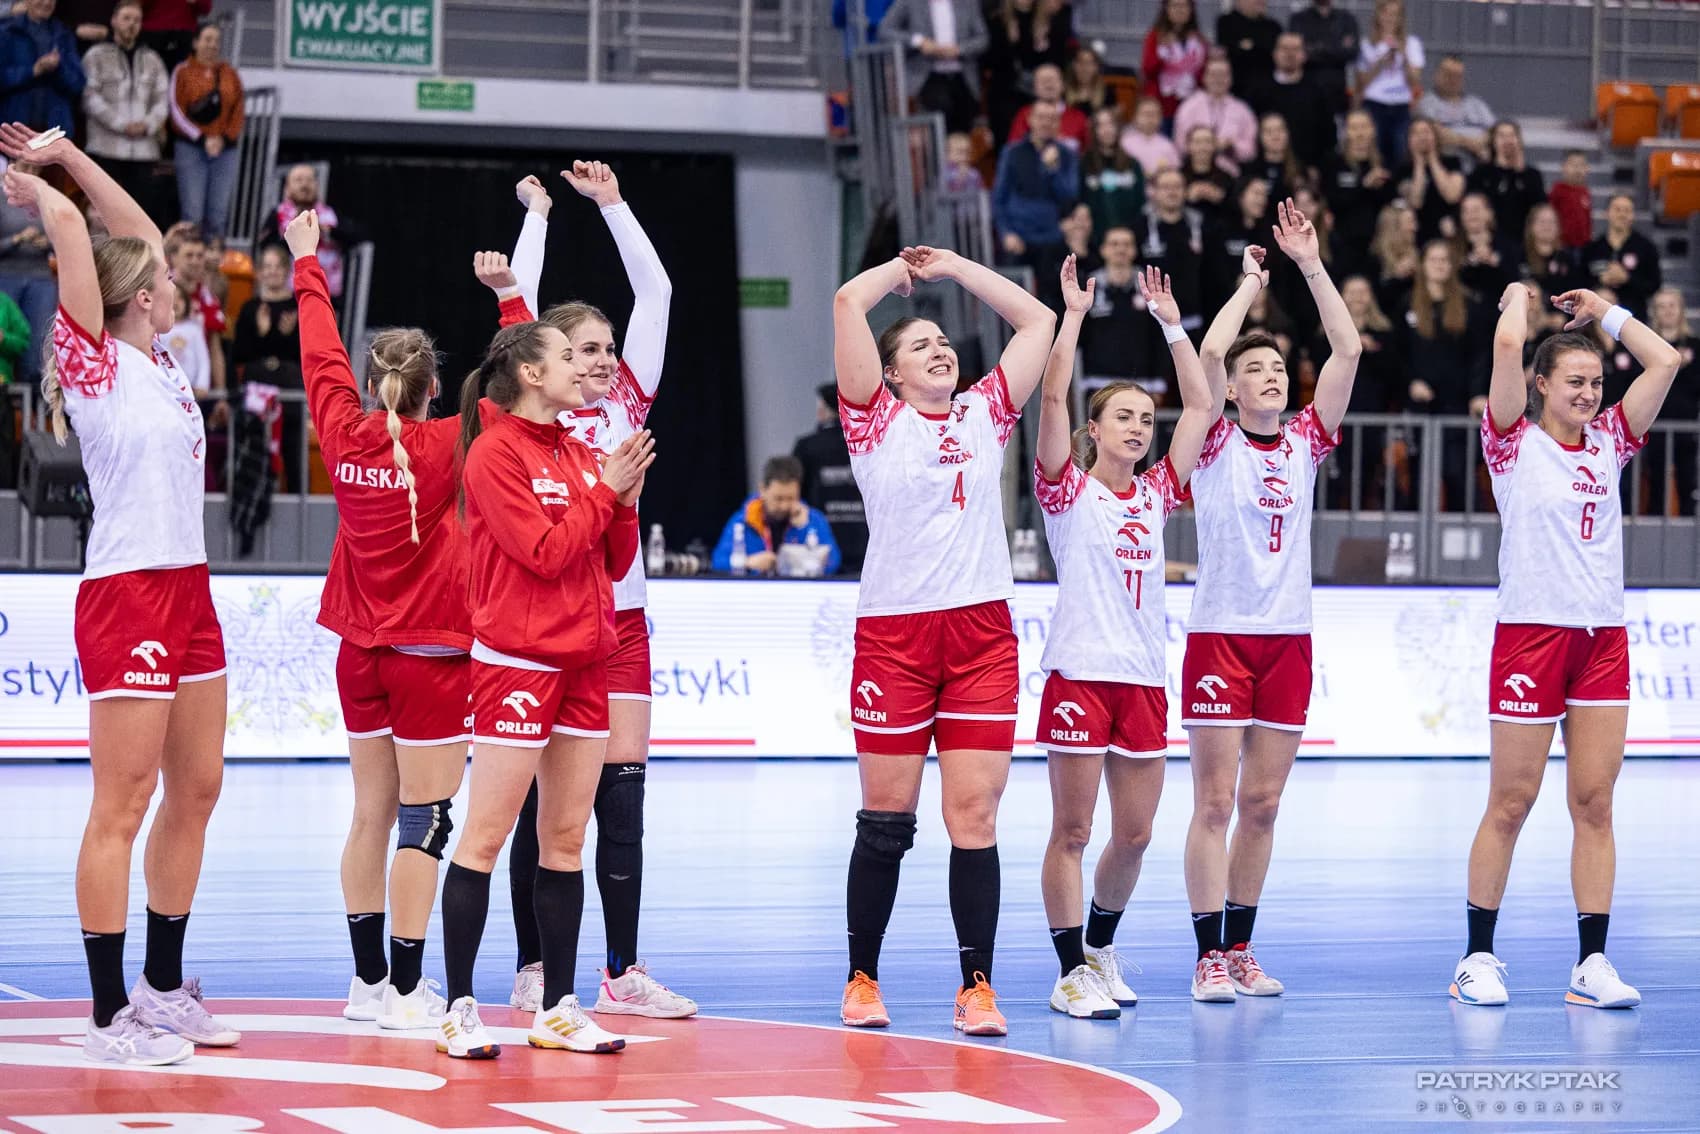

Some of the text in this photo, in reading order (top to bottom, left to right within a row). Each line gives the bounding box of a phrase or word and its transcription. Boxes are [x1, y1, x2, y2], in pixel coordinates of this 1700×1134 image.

[296, 1, 429, 36] WYJŚCIE
[951, 471, 966, 511] 4
[1572, 482, 1608, 496] ORLEN
[1581, 502, 1596, 539] 6
[1269, 515, 1283, 552] 9
[1115, 548, 1151, 560] ORLEN
[1123, 569, 1143, 610] 11
[123, 671, 170, 686] ORLEN
[1191, 702, 1231, 714] ORLEN
[1499, 700, 1539, 713] ORLEN
[854, 707, 887, 722] ORLEN
[495, 720, 542, 735] ORLEN
[1050, 728, 1089, 742] ORLEN
